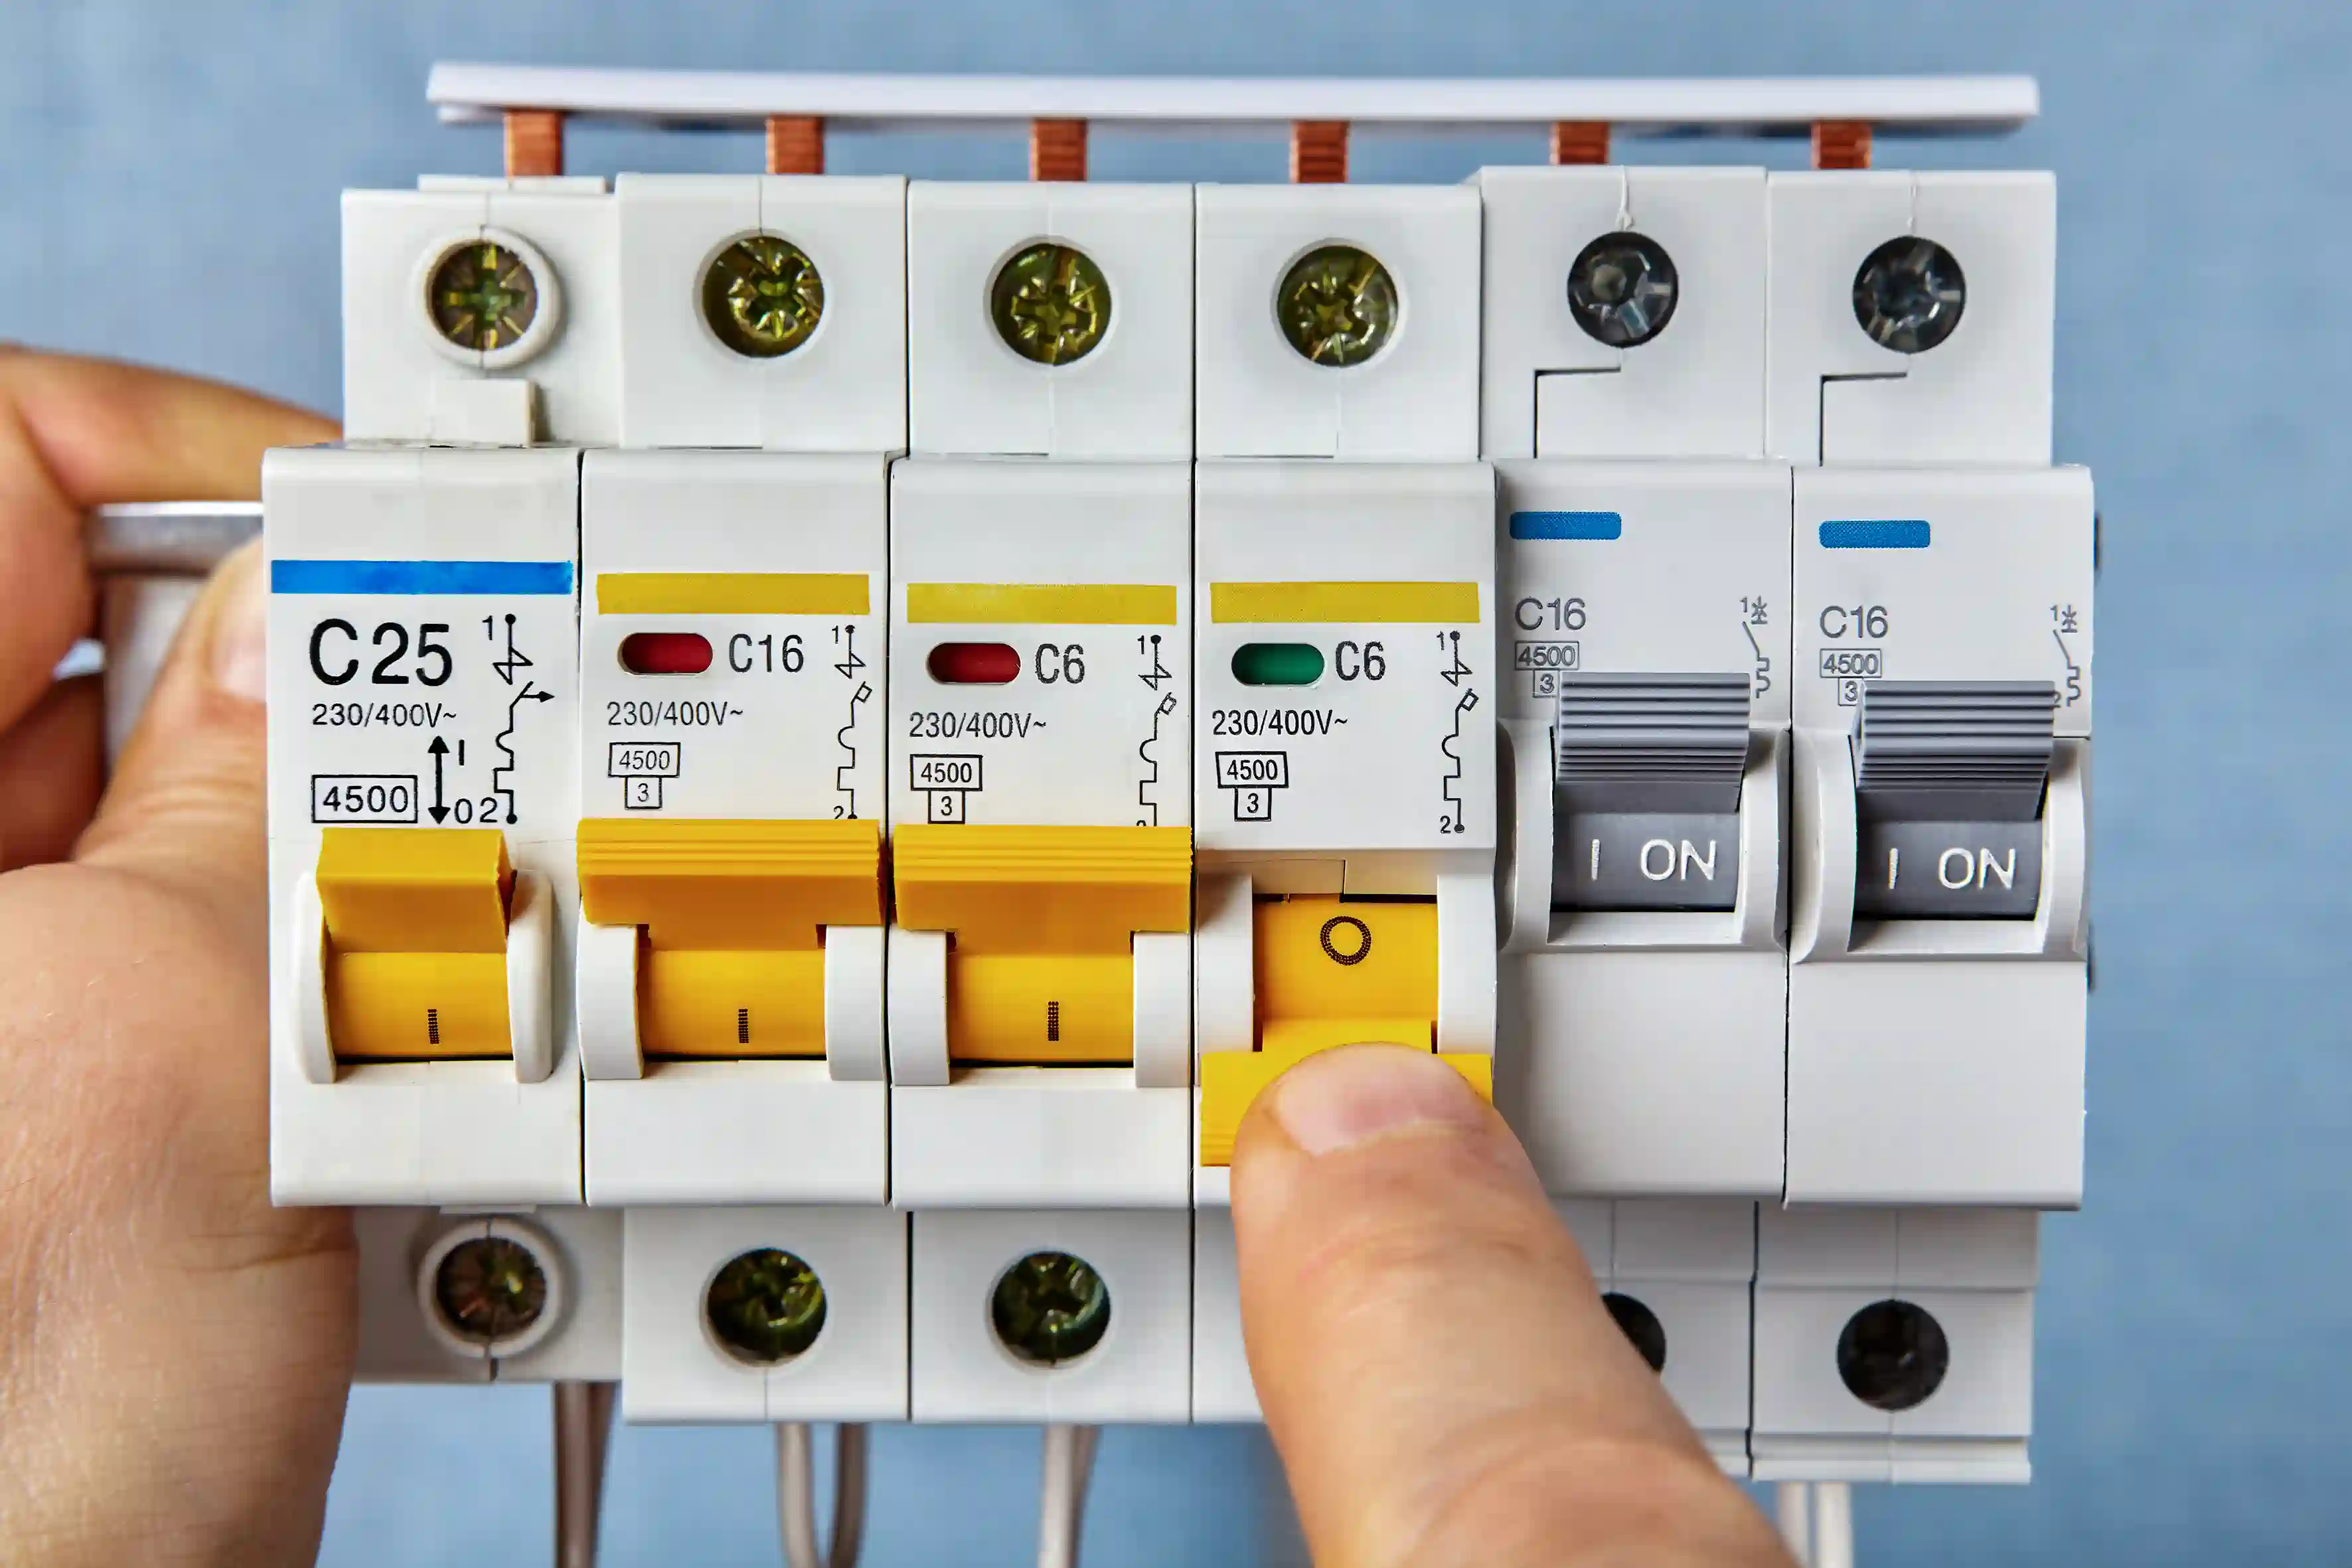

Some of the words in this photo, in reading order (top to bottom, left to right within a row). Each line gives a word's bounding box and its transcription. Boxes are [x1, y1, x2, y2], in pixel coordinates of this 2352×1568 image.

[1515, 597, 1586, 631] C16
[1820, 605, 1889, 639] C16
[482, 615, 493, 641] 1
[831, 625, 840, 644] 1
[309, 618, 453, 686] C25
[730, 633, 804, 673] C16
[1137, 635, 1144, 655] 1
[1518, 645, 1576, 666] 4500
[1036, 643, 1086, 684] C6
[1335, 641, 1386, 681] C6
[1823, 653, 1879, 674] 4500
[1539, 674, 1555, 694] 3
[1845, 680, 1857, 702] 3
[619, 750, 670, 770] 4500
[1227, 759, 1279, 781] 4500
[921, 762, 973, 783] 4500
[323, 785, 409, 813] 4500
[637, 783, 650, 803] 3
[1247, 793, 1259, 814] 3
[941, 796, 953, 817] 3
[1440, 815, 1451, 834] 2
[1640, 839, 1717, 880] ON
[1938, 848, 2017, 890] ON
